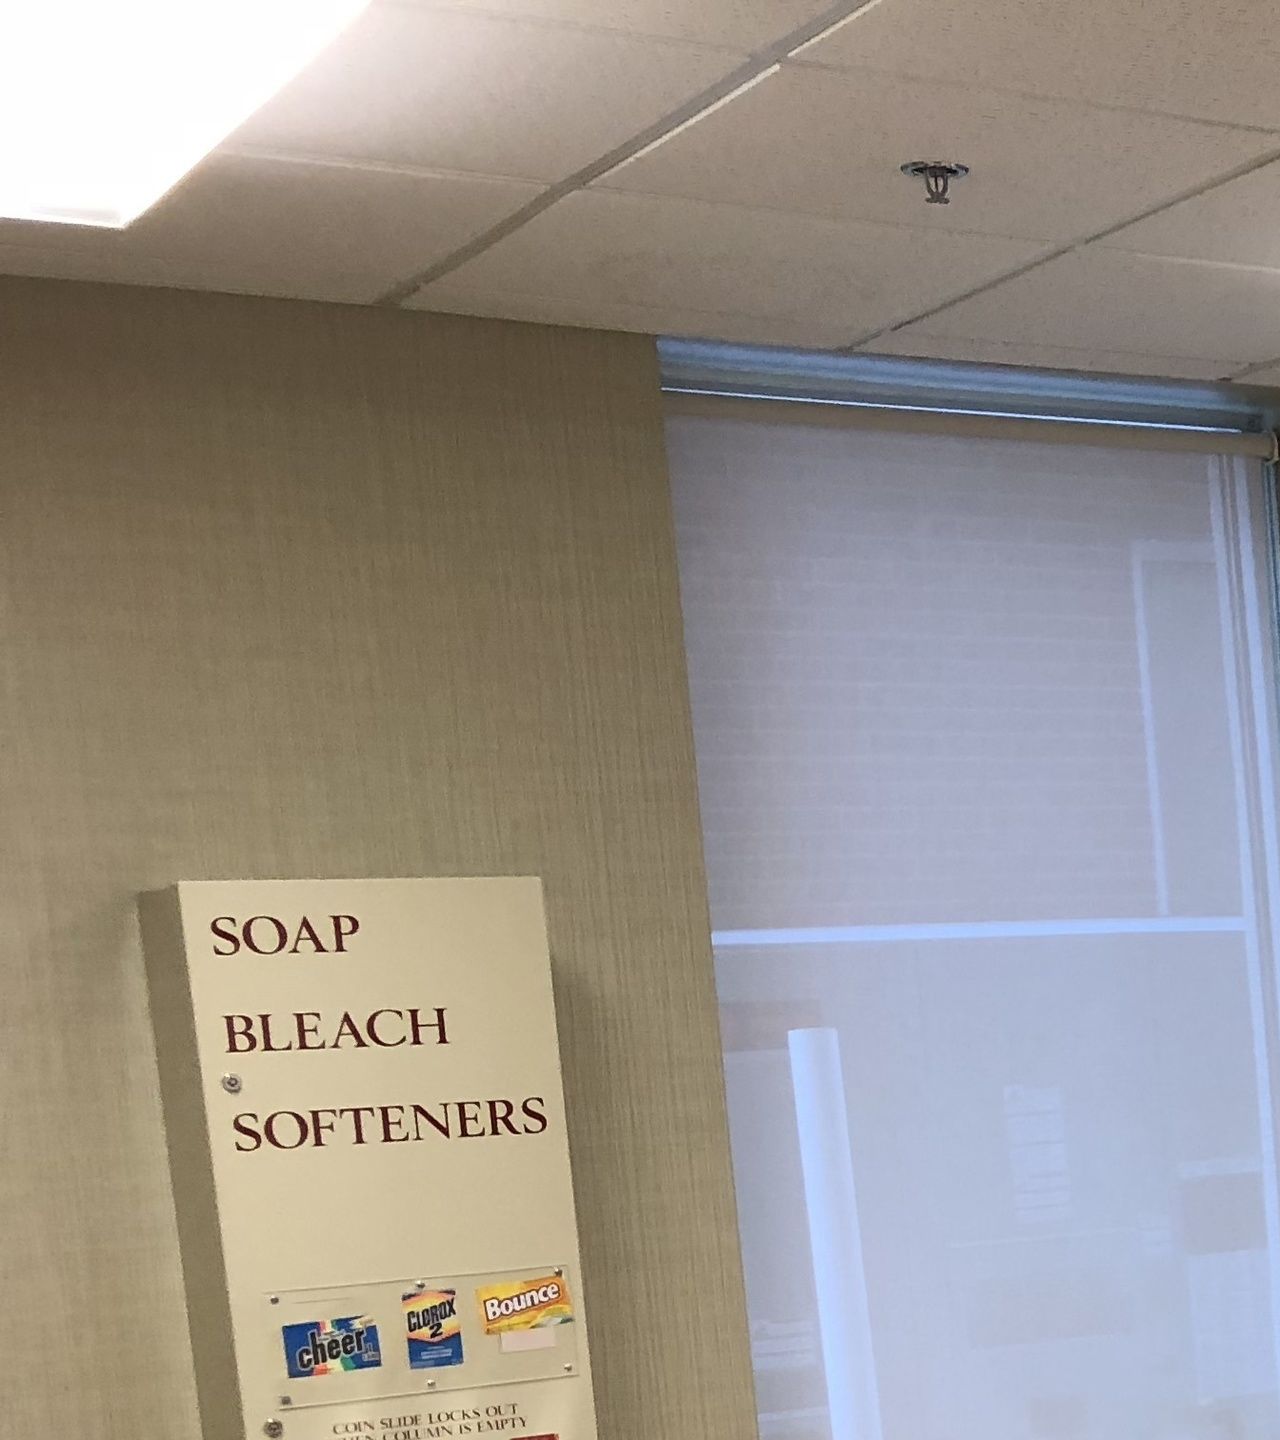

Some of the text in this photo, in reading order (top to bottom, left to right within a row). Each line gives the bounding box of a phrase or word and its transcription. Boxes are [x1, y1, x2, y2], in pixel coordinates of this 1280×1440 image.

[210, 915, 360, 956] SOAP
[222, 1007, 450, 1053] BLEACH
[232, 1097, 548, 1151] SOFTENERS
[406, 1298, 457, 1333] CLOROX
[484, 1282, 561, 1321] Bounce
[296, 1328, 367, 1370] cheer
[429, 1322, 443, 1339] 2
[333, 1403, 519, 1435] COIN SLIDE LOCKS OUT
[459, 1423, 472, 1435] IS
[477, 1416, 529, 1434] EMPTY
